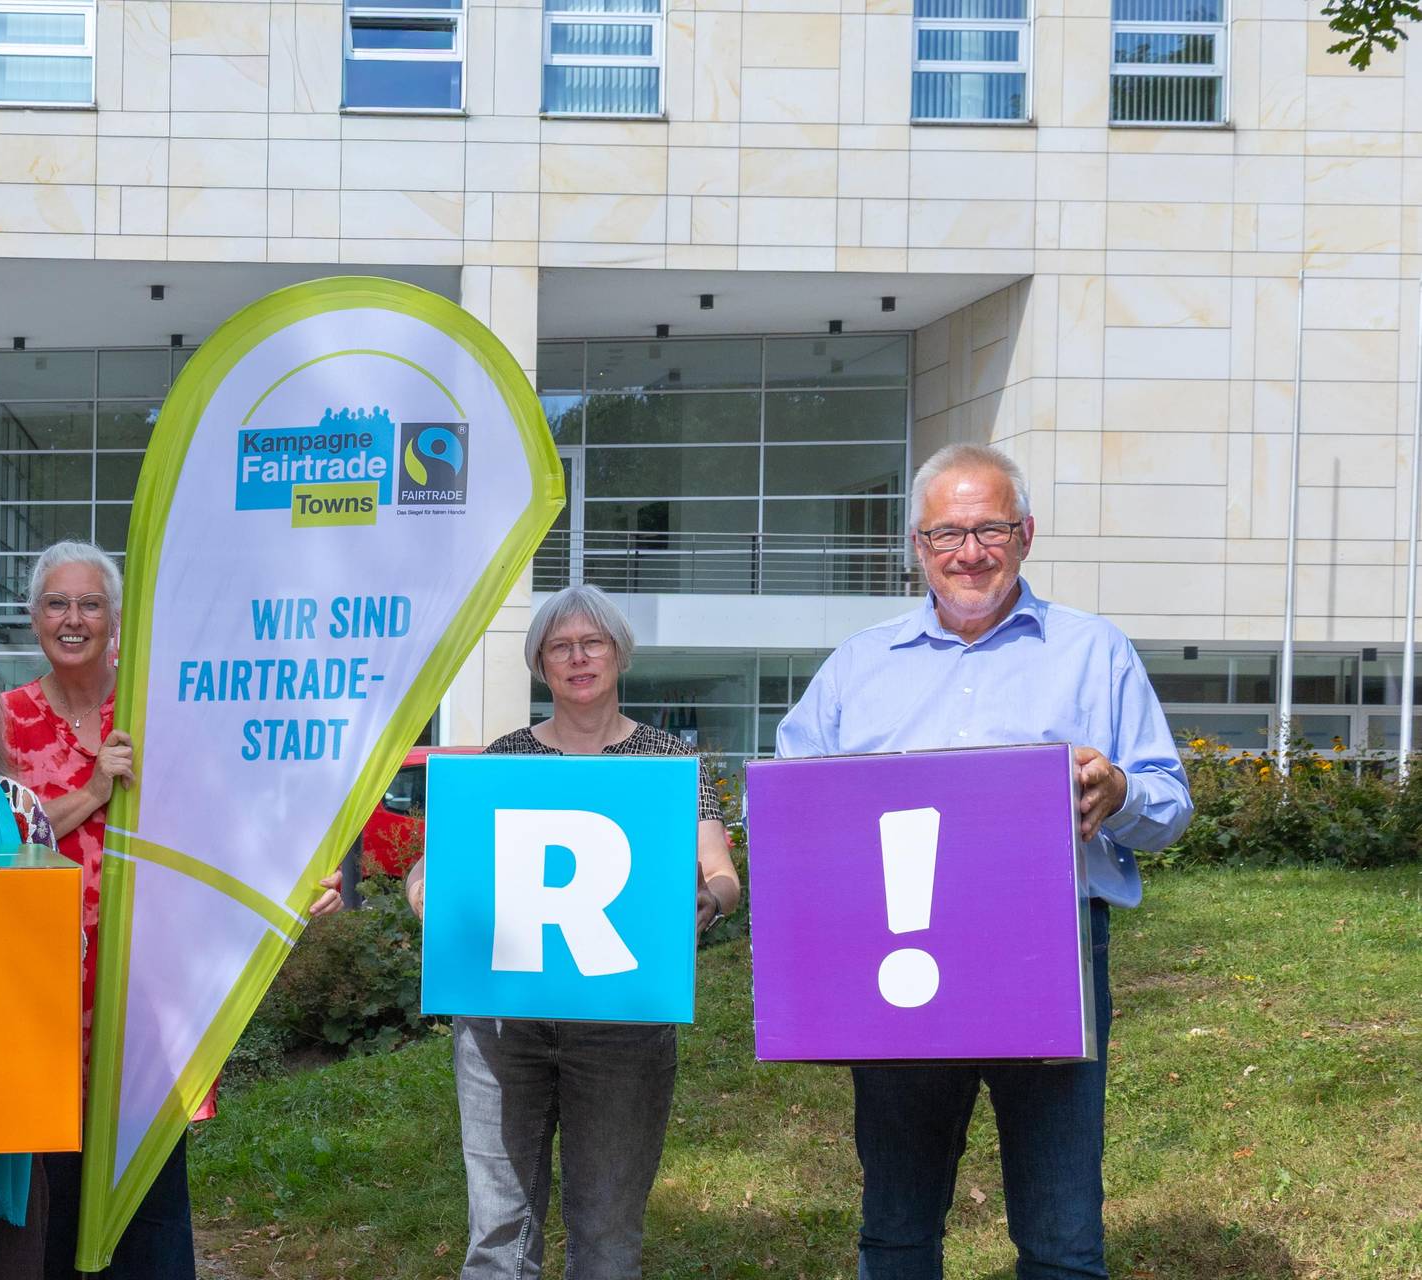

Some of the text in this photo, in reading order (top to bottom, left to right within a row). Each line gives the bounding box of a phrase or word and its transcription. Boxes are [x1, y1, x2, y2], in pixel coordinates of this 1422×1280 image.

[243, 432, 373, 456] Kampagne
[241, 451, 387, 483] Fairtrade
[295, 493, 374, 515] Towns
[401, 490, 464, 501] FAIRTRADE
[251, 595, 412, 640] WIR SIND
[178, 657, 385, 702] FAIRTRADE-
[241, 718, 349, 761] STADT
[491, 808, 639, 976] R
[878, 806, 941, 1008] !
